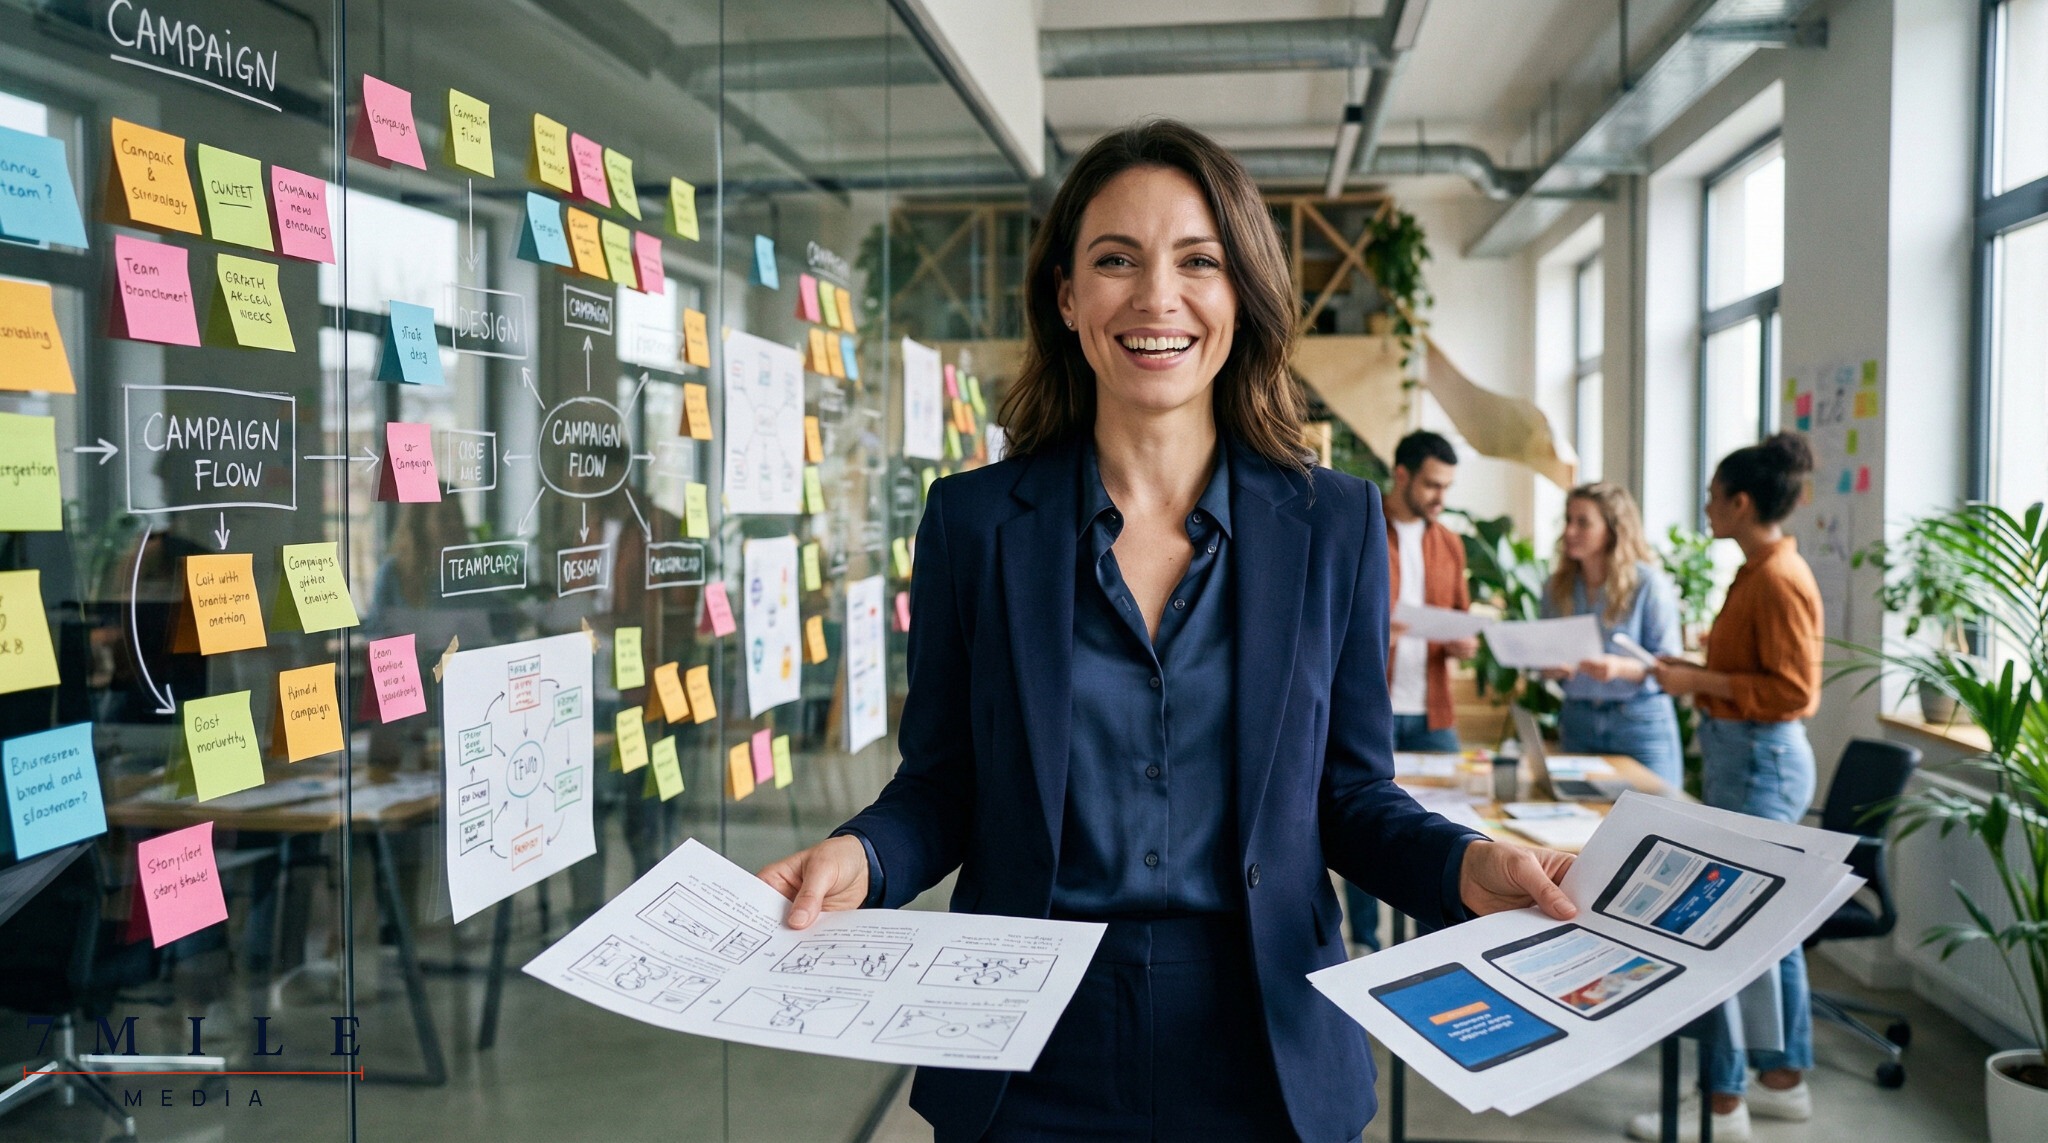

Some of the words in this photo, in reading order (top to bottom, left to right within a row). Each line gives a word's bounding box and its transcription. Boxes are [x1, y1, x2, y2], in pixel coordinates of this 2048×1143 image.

[124, 256, 160, 277] Team
[458, 305, 519, 344] DESIGN
[143, 411, 281, 452] CAMPAIGN
[552, 418, 623, 449] CAMPAIGN
[194, 458, 263, 491] FLOW
[568, 452, 607, 479] FLOW
[563, 557, 603, 583] DESIGN
[60, 766, 83, 786] and
